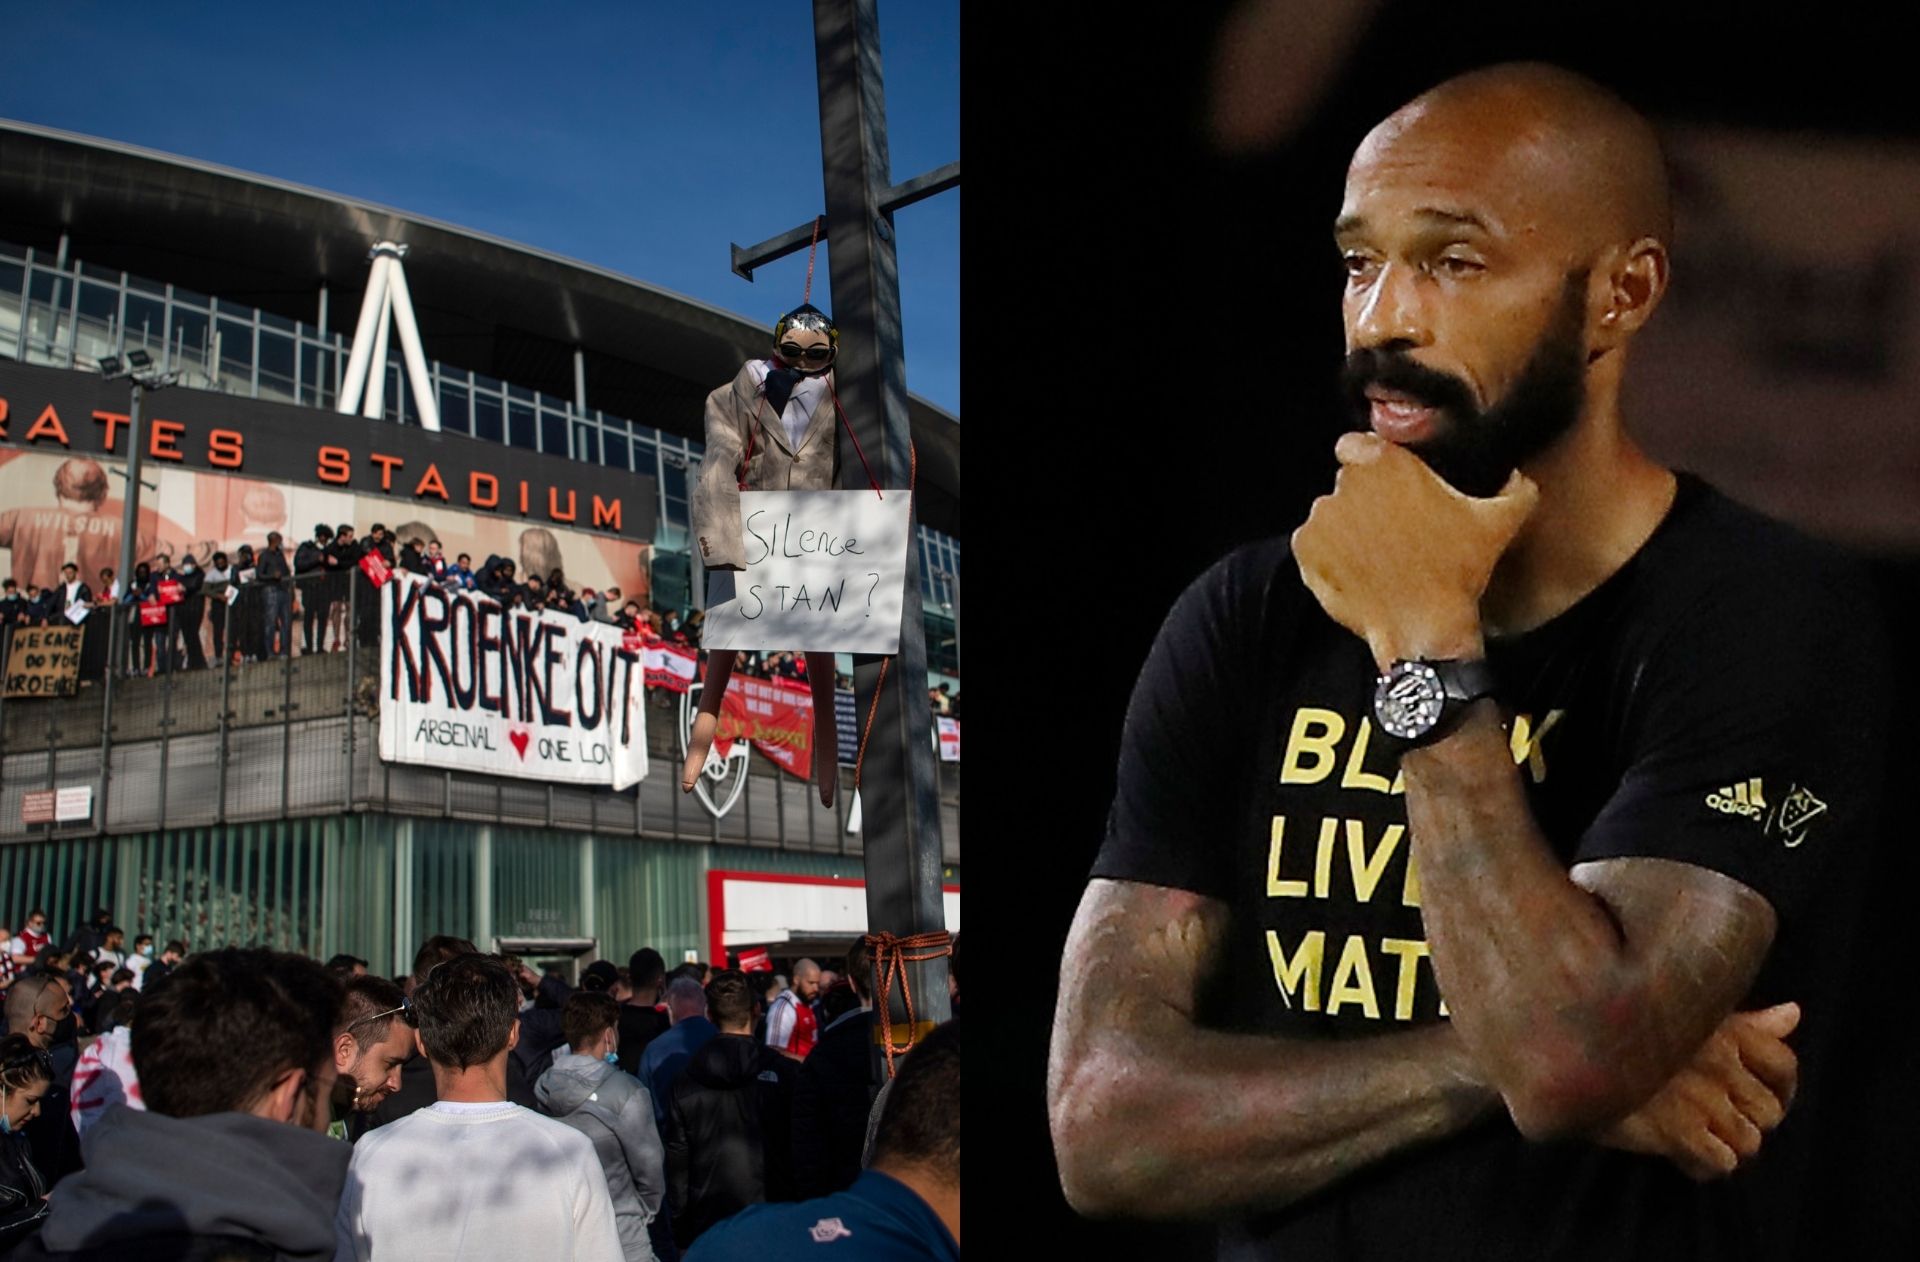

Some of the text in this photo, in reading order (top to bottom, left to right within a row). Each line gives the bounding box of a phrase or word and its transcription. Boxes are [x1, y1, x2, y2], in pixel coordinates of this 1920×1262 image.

[0, 397, 622, 530] ATES STADIUM
[34, 511, 115, 538] WILSON
[740, 579, 845, 619] STAN
[391, 578, 639, 747] KROENKE OUT
[415, 719, 497, 751] ARSENAL
[539, 738, 572, 762] ONE
[1280, 708, 1565, 795] BLK
[1266, 815, 1422, 908] LIV
[1266, 929, 1450, 1021] MAT
